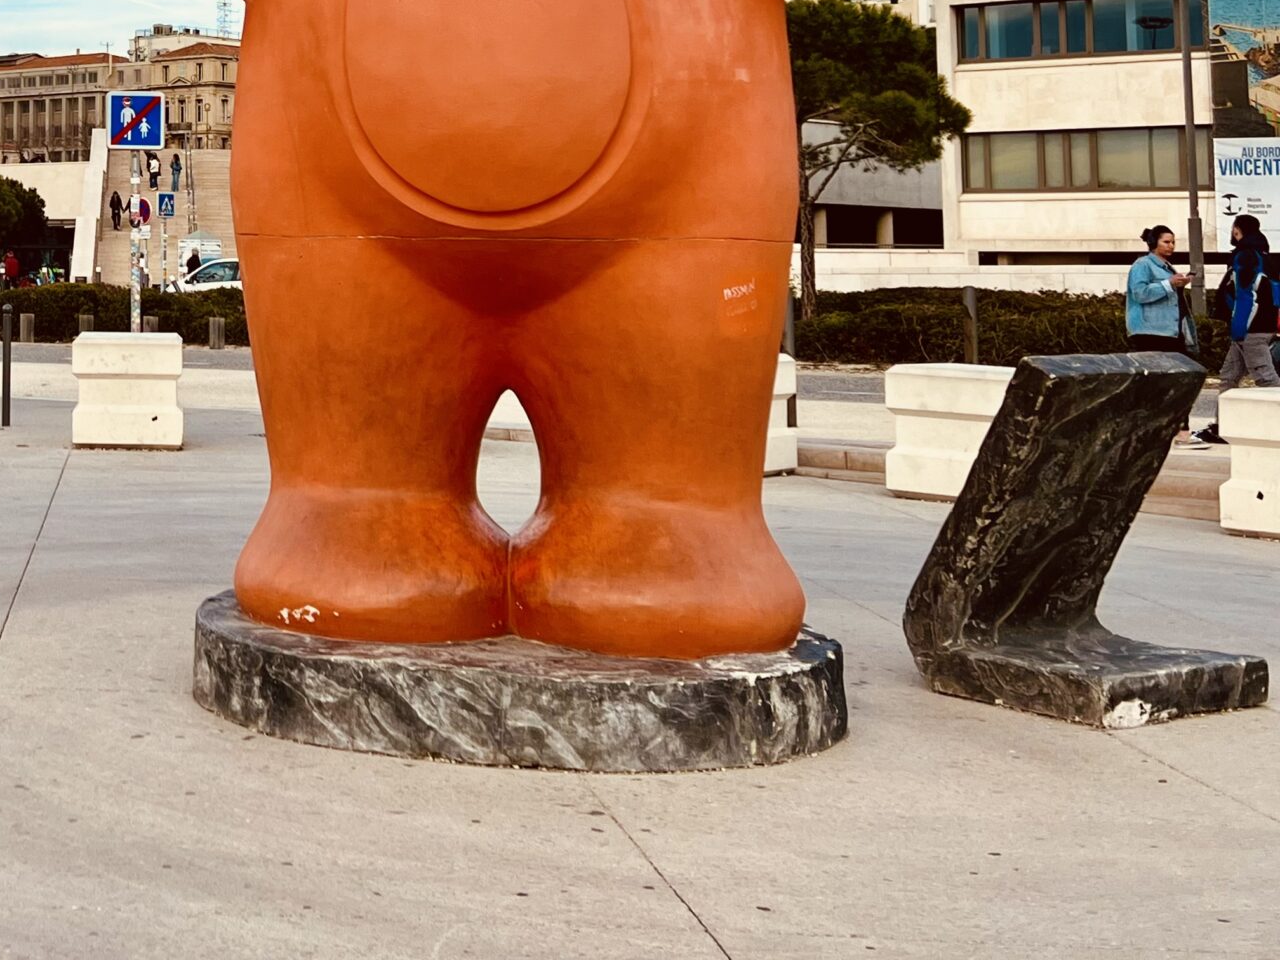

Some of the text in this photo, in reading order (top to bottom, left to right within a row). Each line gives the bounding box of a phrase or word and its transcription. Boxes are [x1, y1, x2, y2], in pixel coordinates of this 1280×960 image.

[1241, 146, 1280, 158] AU BORD
[1218, 158, 1280, 176] VINCENT
